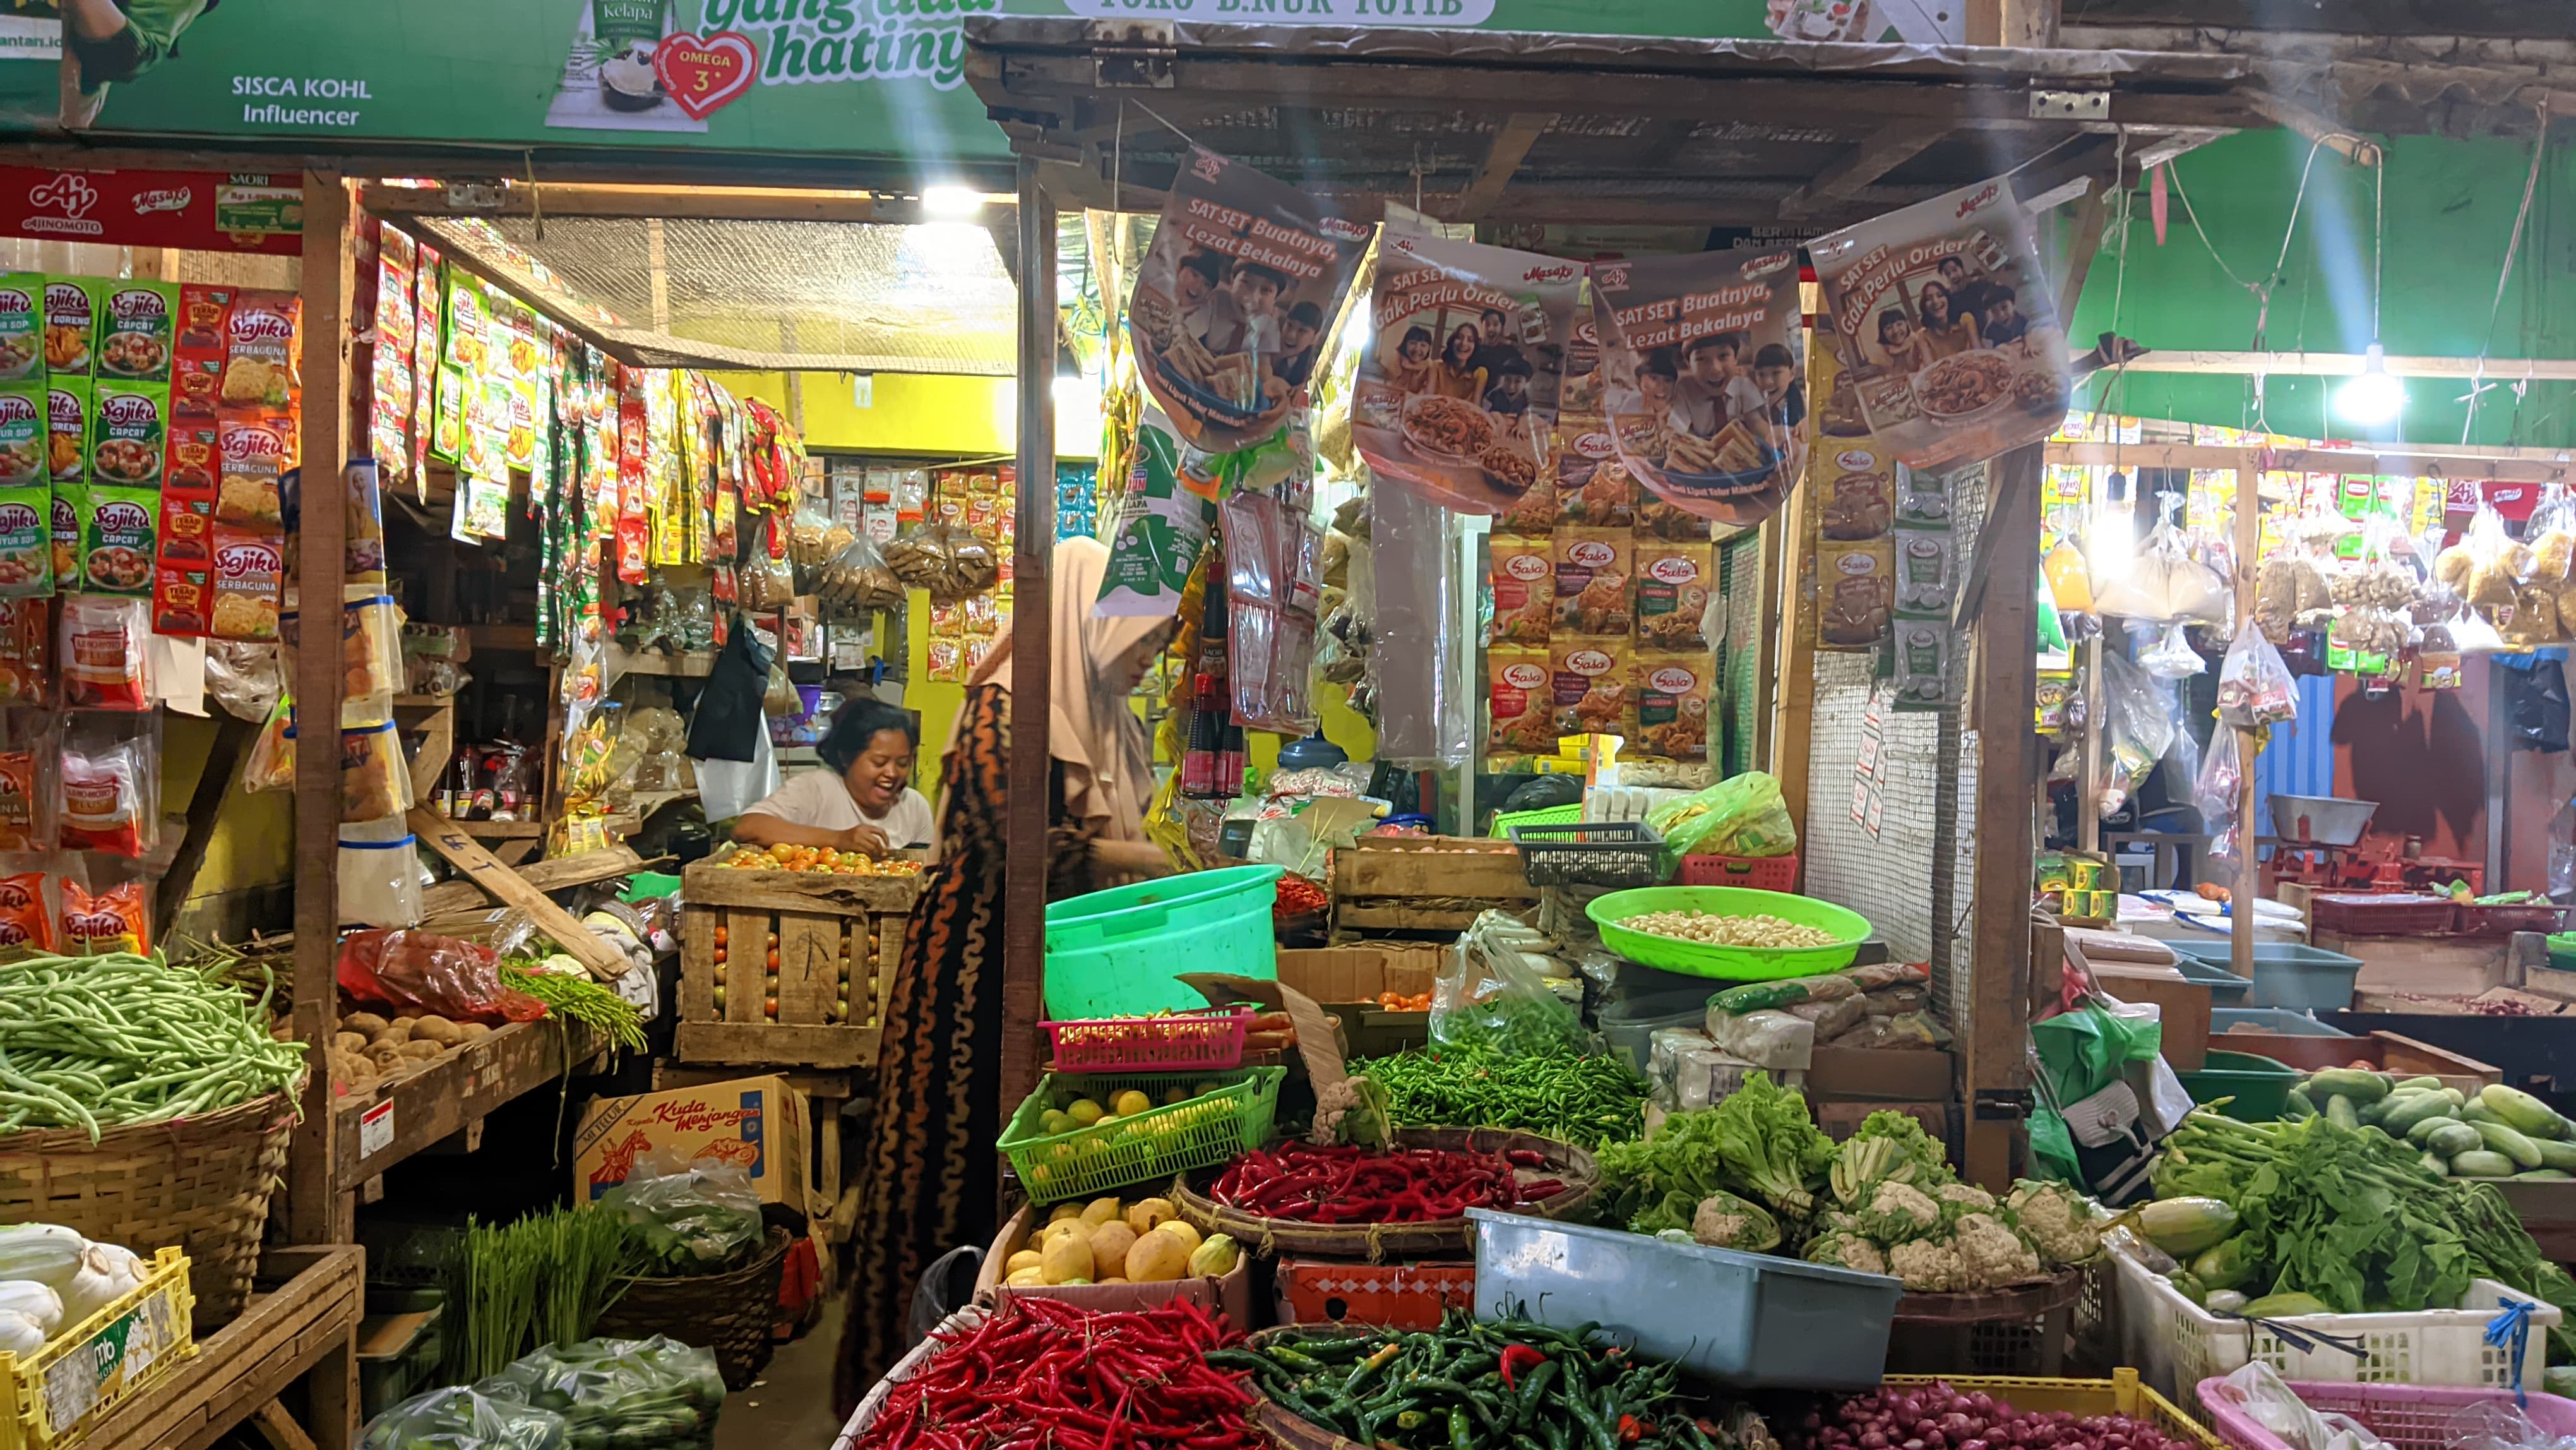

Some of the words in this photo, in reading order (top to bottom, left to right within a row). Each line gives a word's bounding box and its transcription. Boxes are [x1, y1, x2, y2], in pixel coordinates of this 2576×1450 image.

[604, 4, 653, 21] Kelapa
[679, 51, 731, 68] OMEGA
[232, 76, 297, 97] SISCA
[304, 78, 372, 99] KOHL
[244, 104, 359, 126] Influencer
[229, 174, 268, 186] SAORI
[133, 187, 190, 212] Masako
[23, 217, 100, 232] AJINOMOTO
[1188, 198, 1218, 220] SAT
[1220, 207, 1250, 230] SET
[1252, 219, 1337, 261] Buatnya,
[1186, 224, 1236, 251] Lezat
[1238, 243, 1323, 279] Bekalnya
[1840, 262, 1866, 291] SAT
[1864, 244, 1890, 270] SET
[1393, 272, 1419, 292] SAT
[1840, 294, 1871, 336] Gak
[1864, 257, 1906, 299] Perlu
[1909, 239, 1969, 265] Order
[109, 291, 166, 320] Sajiku
[1373, 296, 1406, 329] Gak
[1409, 286, 1458, 313] Perlu
[1462, 284, 1520, 311] Order
[1616, 308, 1644, 327] SAT
[1647, 301, 1676, 320] SET
[1683, 283, 1772, 314] Buatnya,
[117, 320, 155, 331] CAPCAY
[229, 315, 294, 343] Sajiku
[1627, 323, 1675, 350] Lezat
[1679, 309, 1765, 339] Bekalnya
[102, 399, 158, 428] Sajiku
[109, 427, 146, 437] CAPCAY
[220, 431, 286, 460] Sajiku
[93, 506, 150, 534] Sajiku
[102, 534, 140, 545] CAPCAY
[215, 547, 282, 578] Sajiku
[1512, 557, 1544, 575] Sasa
[1577, 544, 1609, 563] Sasa
[1509, 666, 1542, 683] Sasa
[1573, 653, 1606, 671] Sasa
[1655, 671, 1690, 687] Sasa
[64, 911, 129, 945] Sajiku
[653, 1099, 707, 1125] Kuda
[675, 1107, 761, 1132] Menjangan
[582, 1129, 595, 1145] MI
[596, 1105, 624, 1134] TELUR
